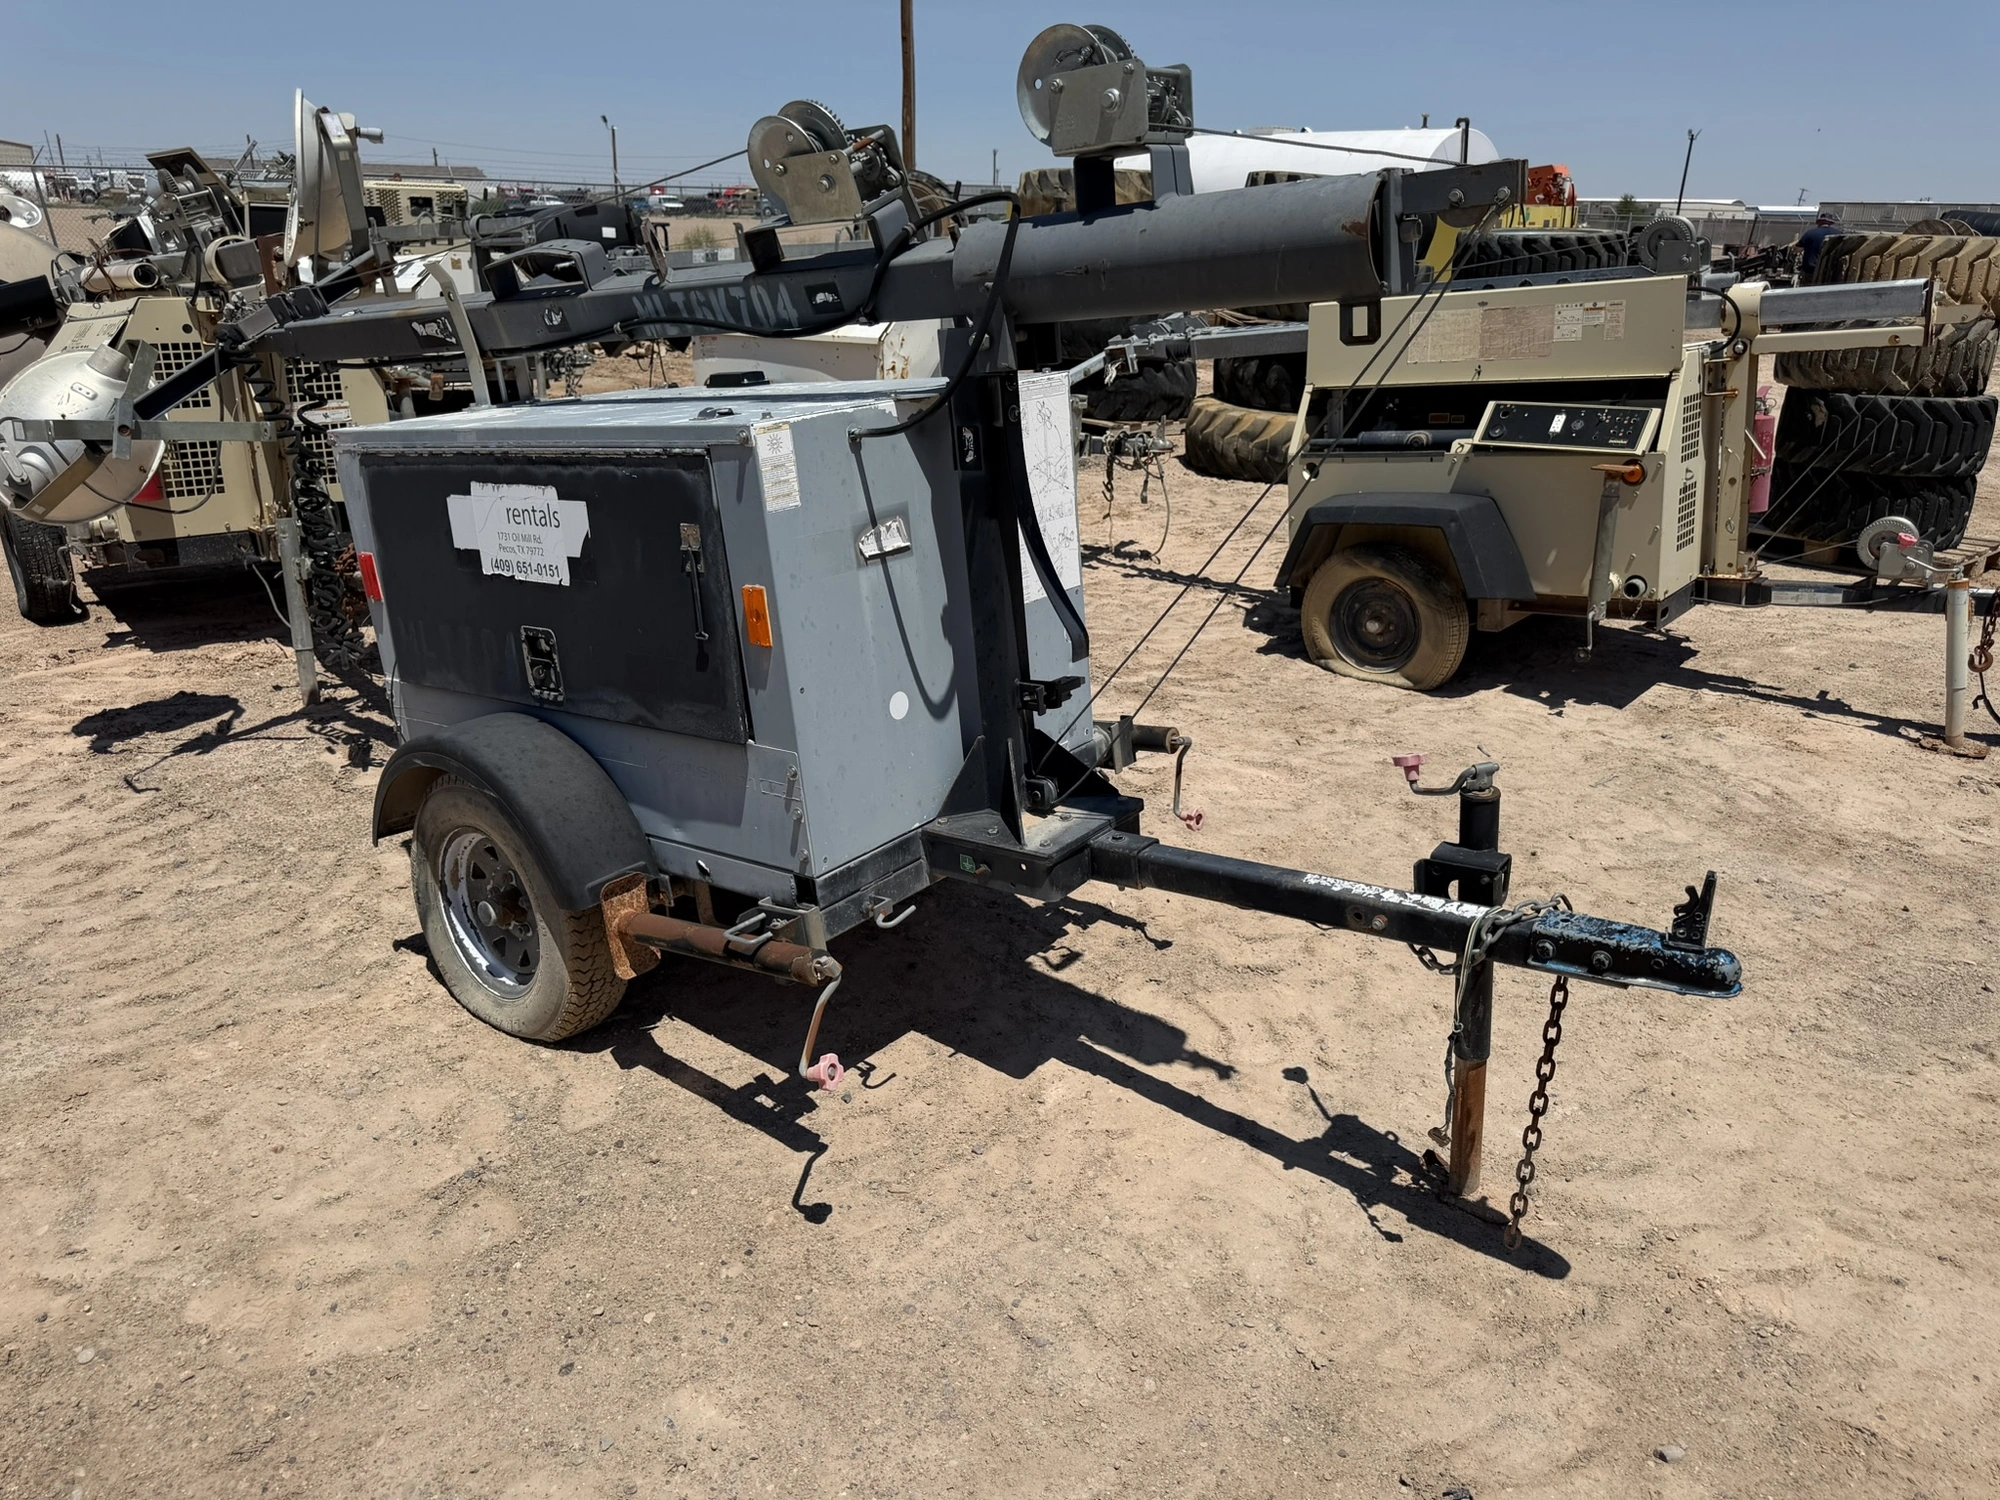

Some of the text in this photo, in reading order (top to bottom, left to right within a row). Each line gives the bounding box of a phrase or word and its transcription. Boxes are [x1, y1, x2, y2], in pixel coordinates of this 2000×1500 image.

[505, 503, 561, 528] rentals
[497, 531, 543, 544] 1731 Oil Mill Rd.
[498, 543, 545, 557] Pecos, TX 79772
[490, 557, 561, 578] (409) 651-0151
